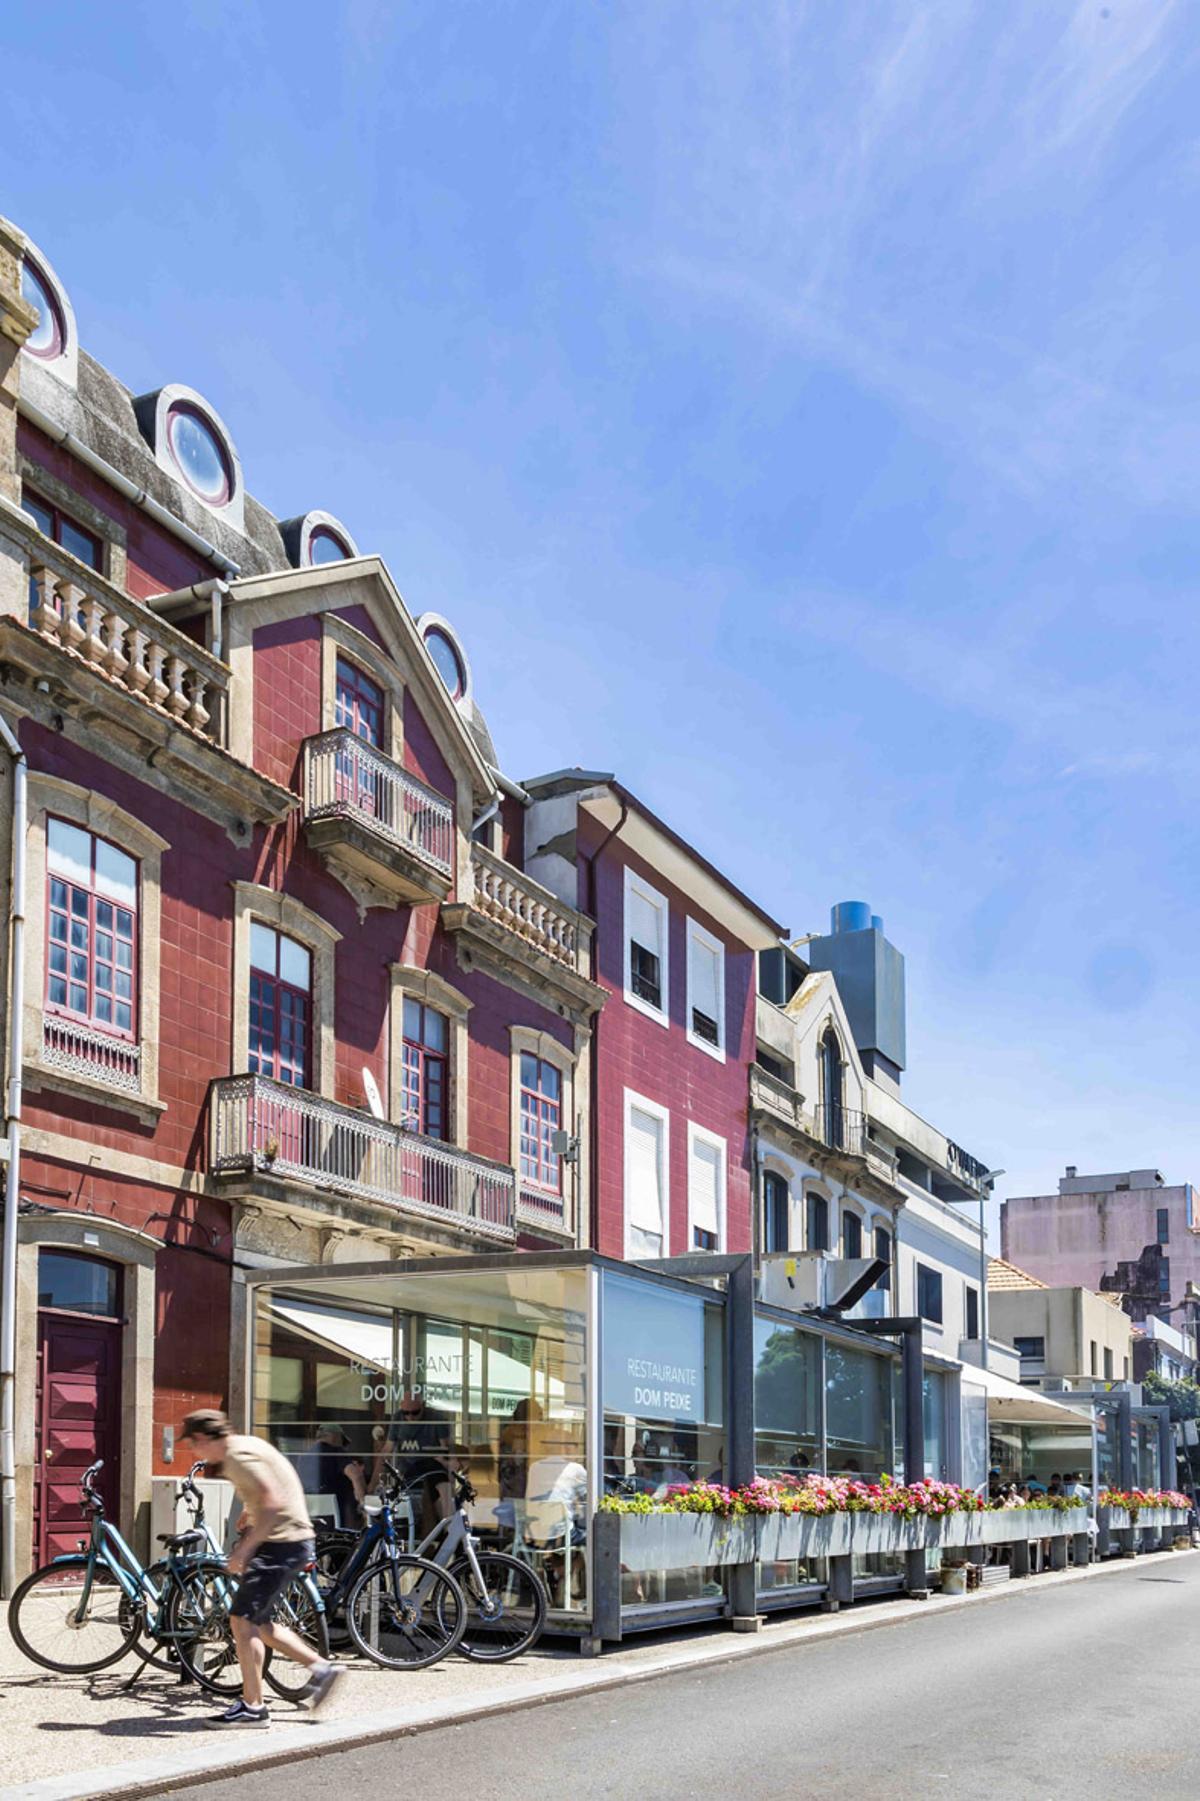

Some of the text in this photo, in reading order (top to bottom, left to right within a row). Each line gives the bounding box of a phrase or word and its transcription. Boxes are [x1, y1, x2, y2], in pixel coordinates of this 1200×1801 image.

[350, 1355, 474, 1375] RESTAURANTE
[627, 1358, 697, 1387] RESTAURANTE
[361, 1383, 461, 1402] DOM PEIXE
[635, 1387, 692, 1411] DOM PEIXE
